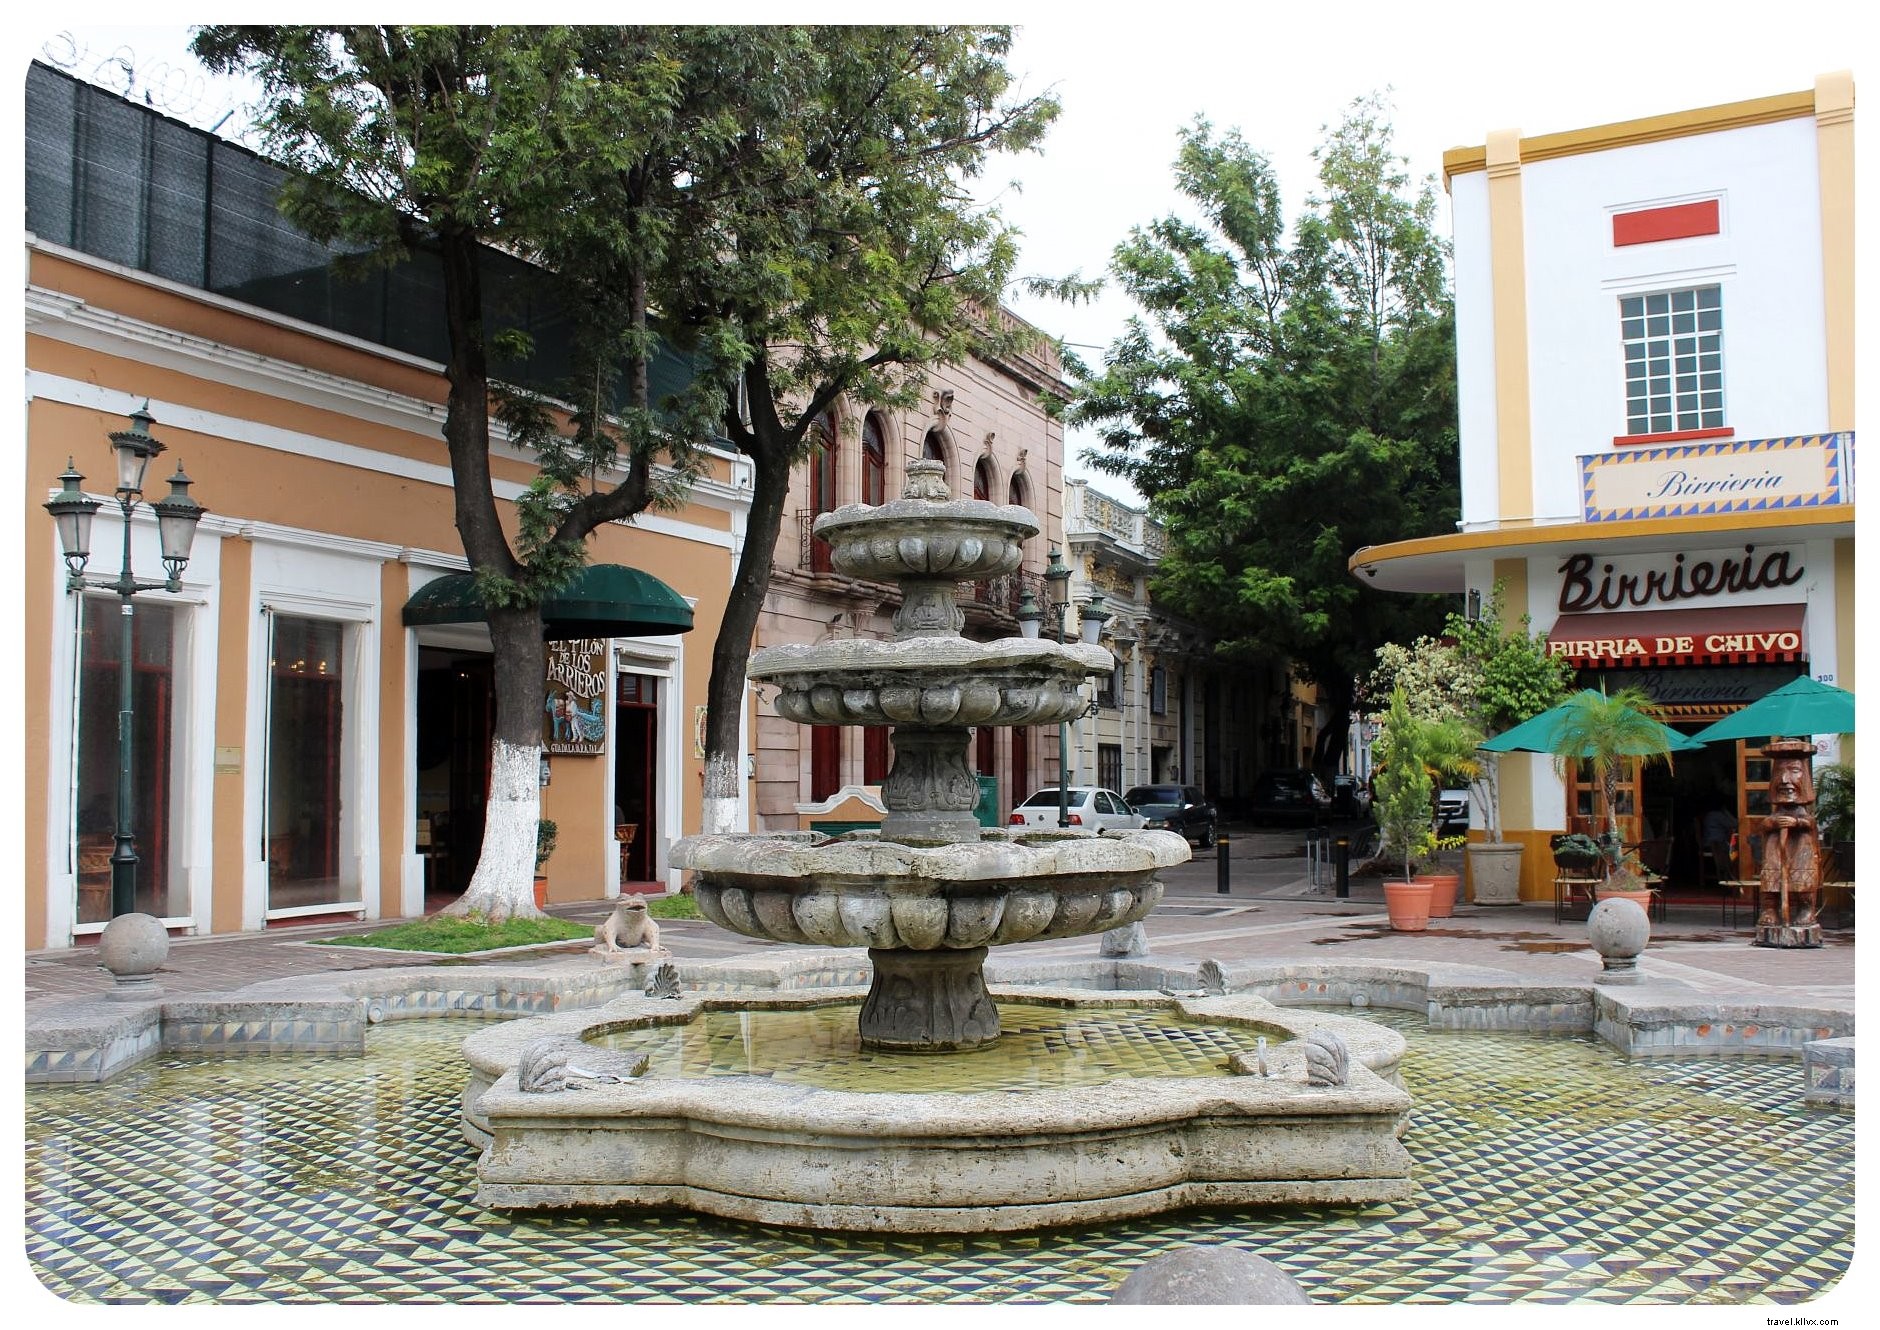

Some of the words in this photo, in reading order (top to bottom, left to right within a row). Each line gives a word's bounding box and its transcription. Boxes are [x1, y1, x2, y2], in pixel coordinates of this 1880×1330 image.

[1647, 470, 1783, 498] Birrieria
[1558, 544, 1804, 612] Birrieria
[549, 640, 567, 652] EL
[1549, 638, 1648, 660] BIRRIA
[1655, 636, 1694, 654] DE
[1705, 632, 1800, 653] CHIVO
[559, 652, 570, 665] DE
[572, 653, 591, 673] LOS
[546, 656, 605, 698] ARRIEROS
[1817, 674, 1834, 683] 300
